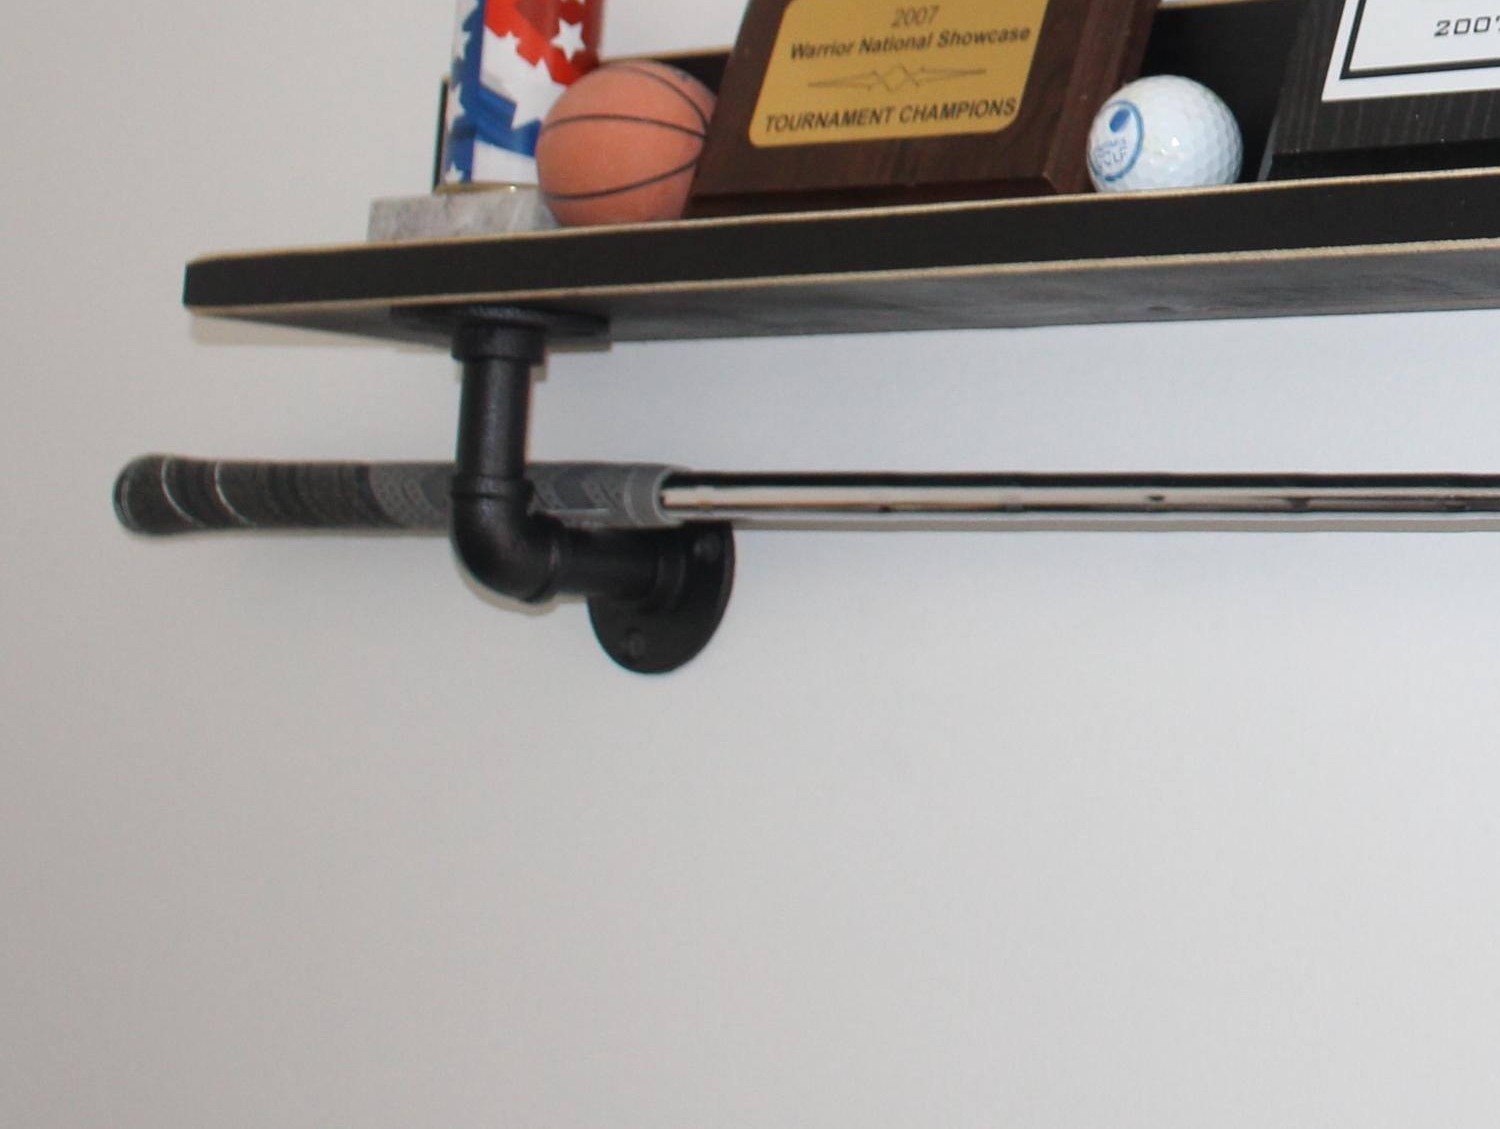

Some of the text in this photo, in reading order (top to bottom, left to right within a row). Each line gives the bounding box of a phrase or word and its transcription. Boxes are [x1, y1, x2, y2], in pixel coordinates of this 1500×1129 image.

[891, 5, 940, 28] 2007
[790, 26, 1031, 60] Warrior National Showcase
[765, 97, 1017, 133] TOURNAMENT CHAMPIONS
